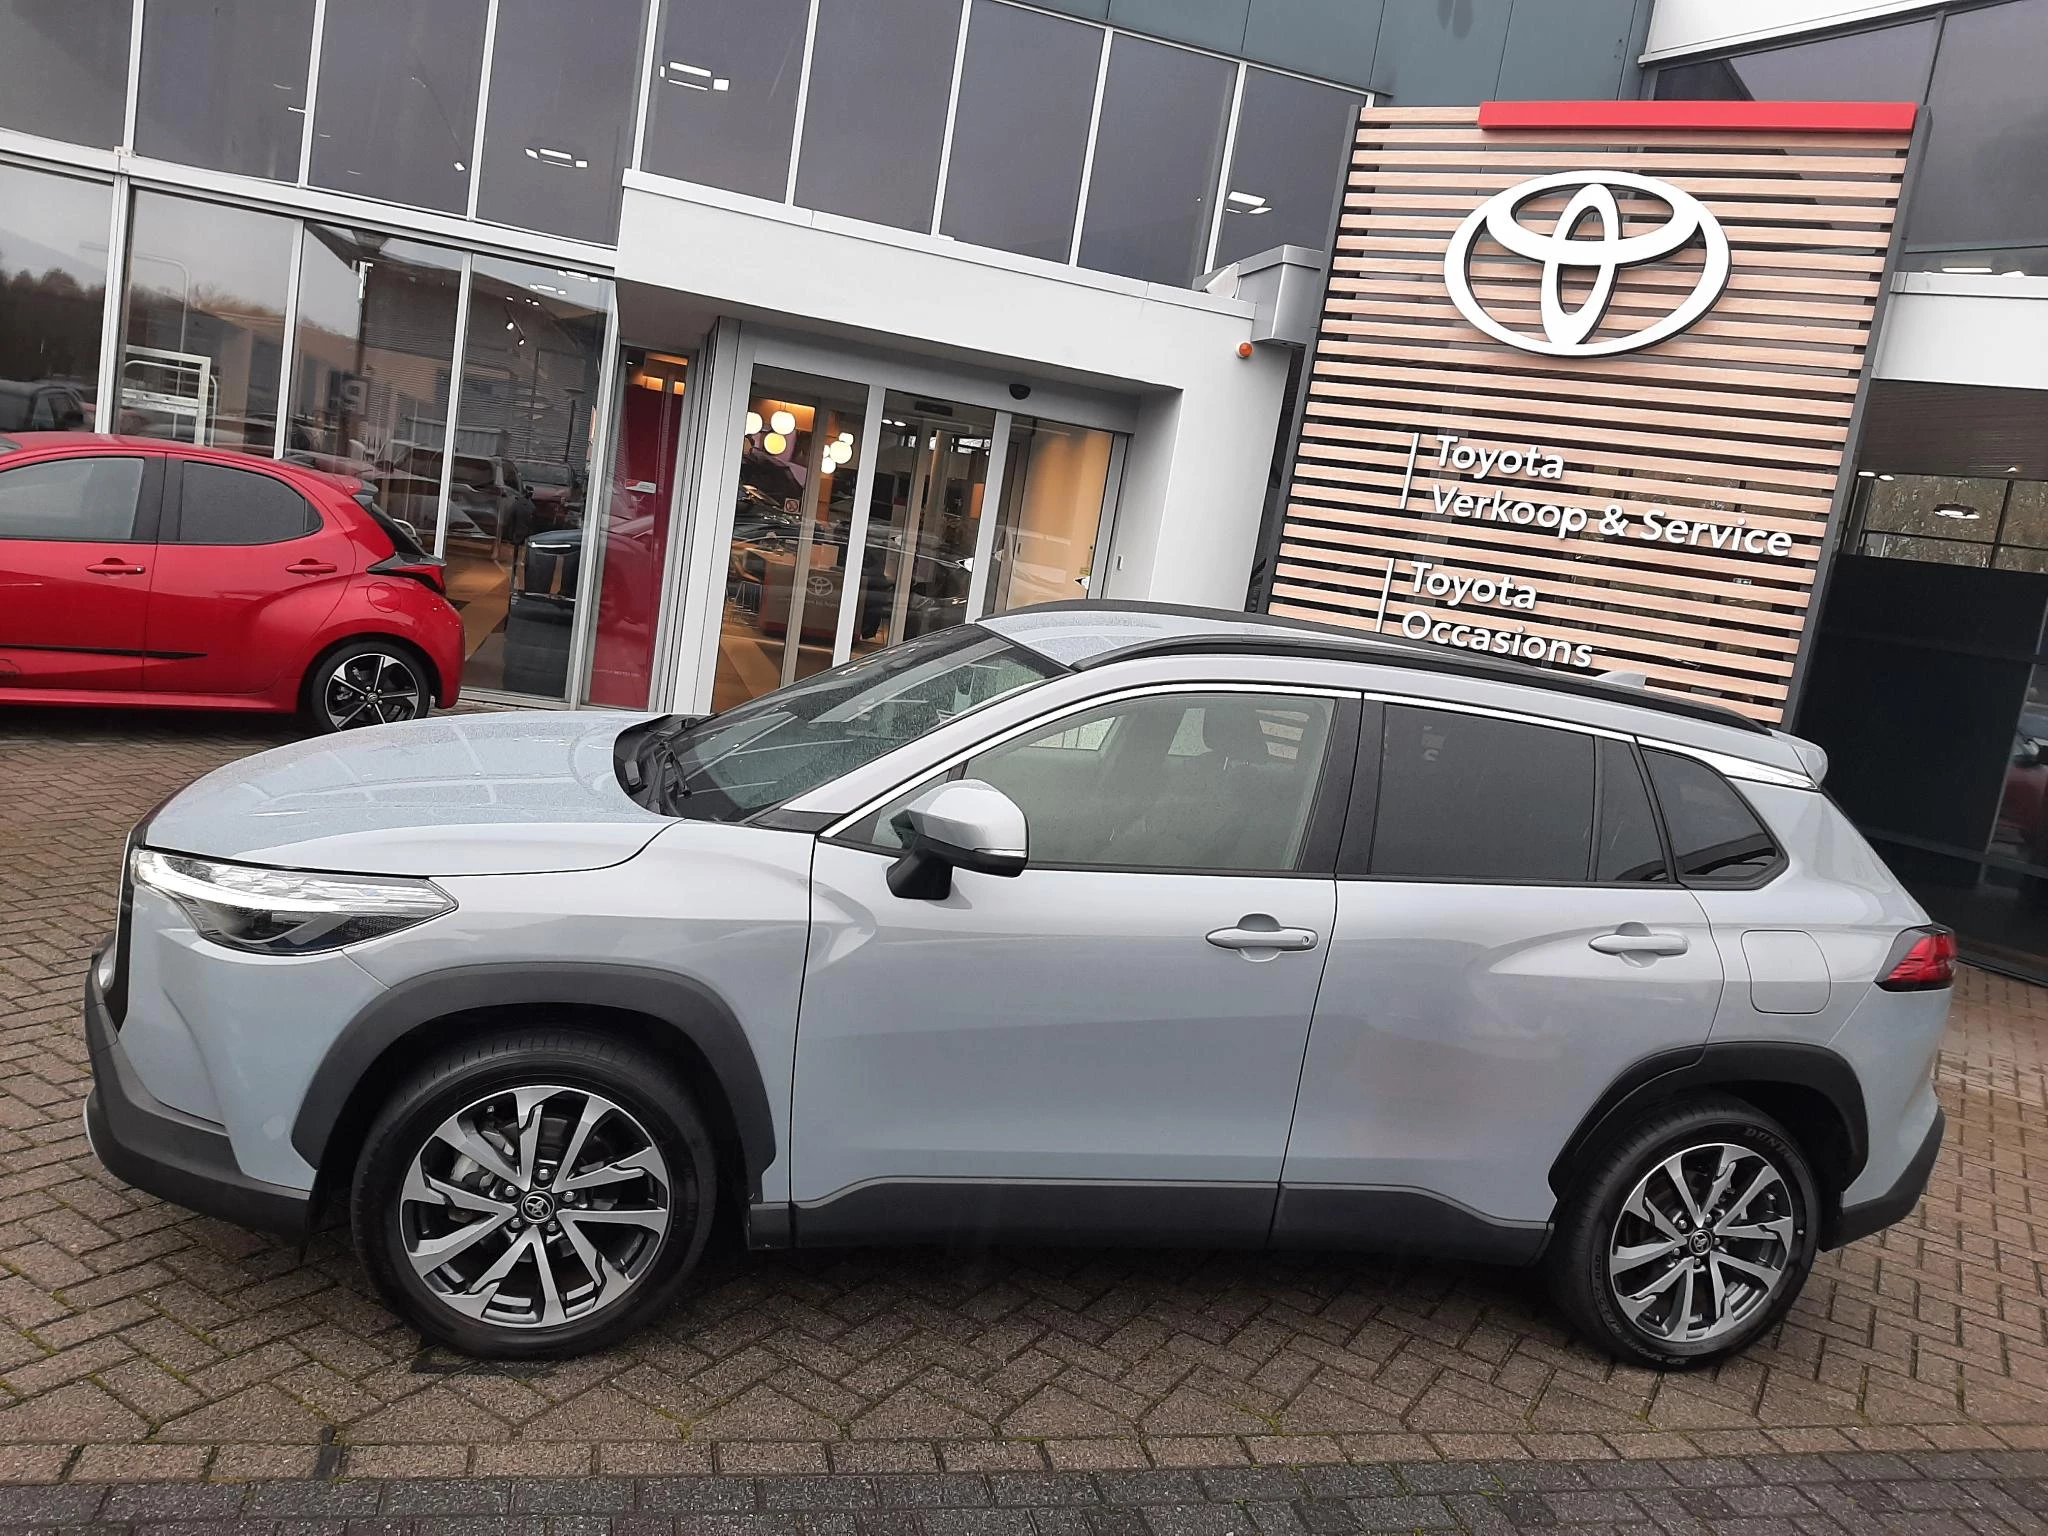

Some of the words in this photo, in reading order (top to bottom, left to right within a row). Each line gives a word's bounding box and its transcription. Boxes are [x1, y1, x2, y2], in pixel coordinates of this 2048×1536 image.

[1434, 434, 1565, 480] Toyota
[1432, 484, 1588, 541] Verkoop
[1598, 504, 1629, 537] &
[1640, 510, 1793, 558] Service
[1410, 561, 1537, 610] Toyota
[1401, 610, 1593, 669] Occasions
[1743, 1126, 1799, 1168] DUNL
